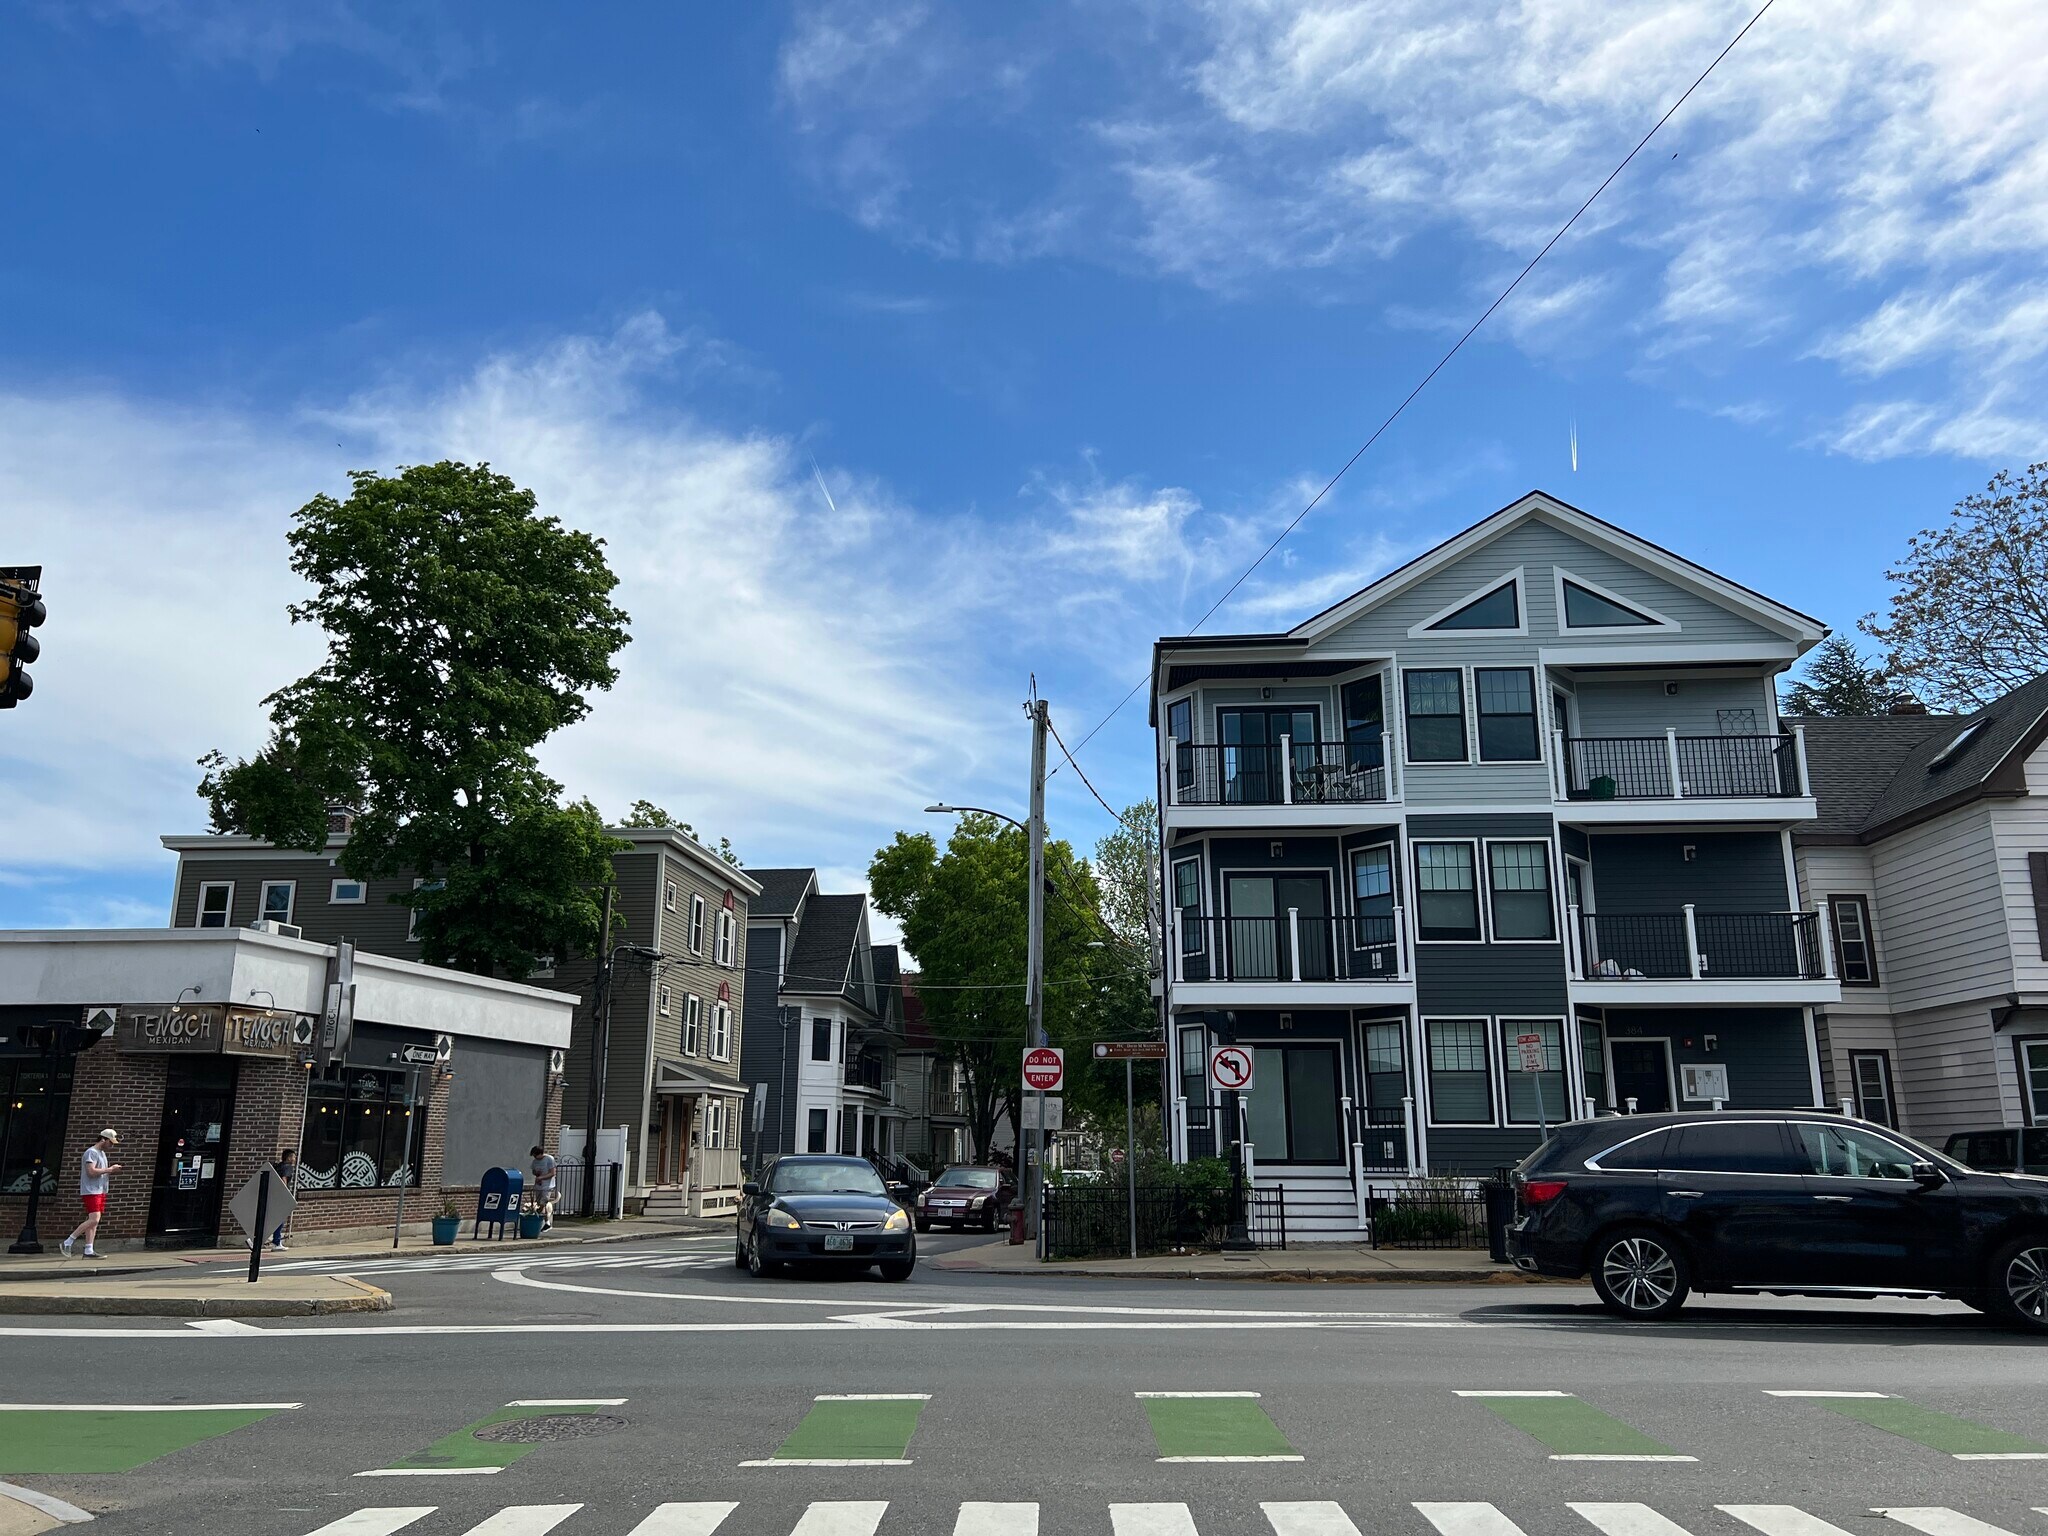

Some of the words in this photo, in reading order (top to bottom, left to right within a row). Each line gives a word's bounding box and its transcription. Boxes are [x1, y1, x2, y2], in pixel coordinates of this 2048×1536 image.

[148, 1036, 192, 1045] MEXICAN
[243, 1039, 275, 1049] MEXICAN
[413, 1051, 423, 1059] ONE
[423, 1052, 435, 1060] WAY
[1029, 1056, 1039, 1064] DO
[1042, 1056, 1057, 1064] NOT
[1031, 1074, 1054, 1082] ENTER
